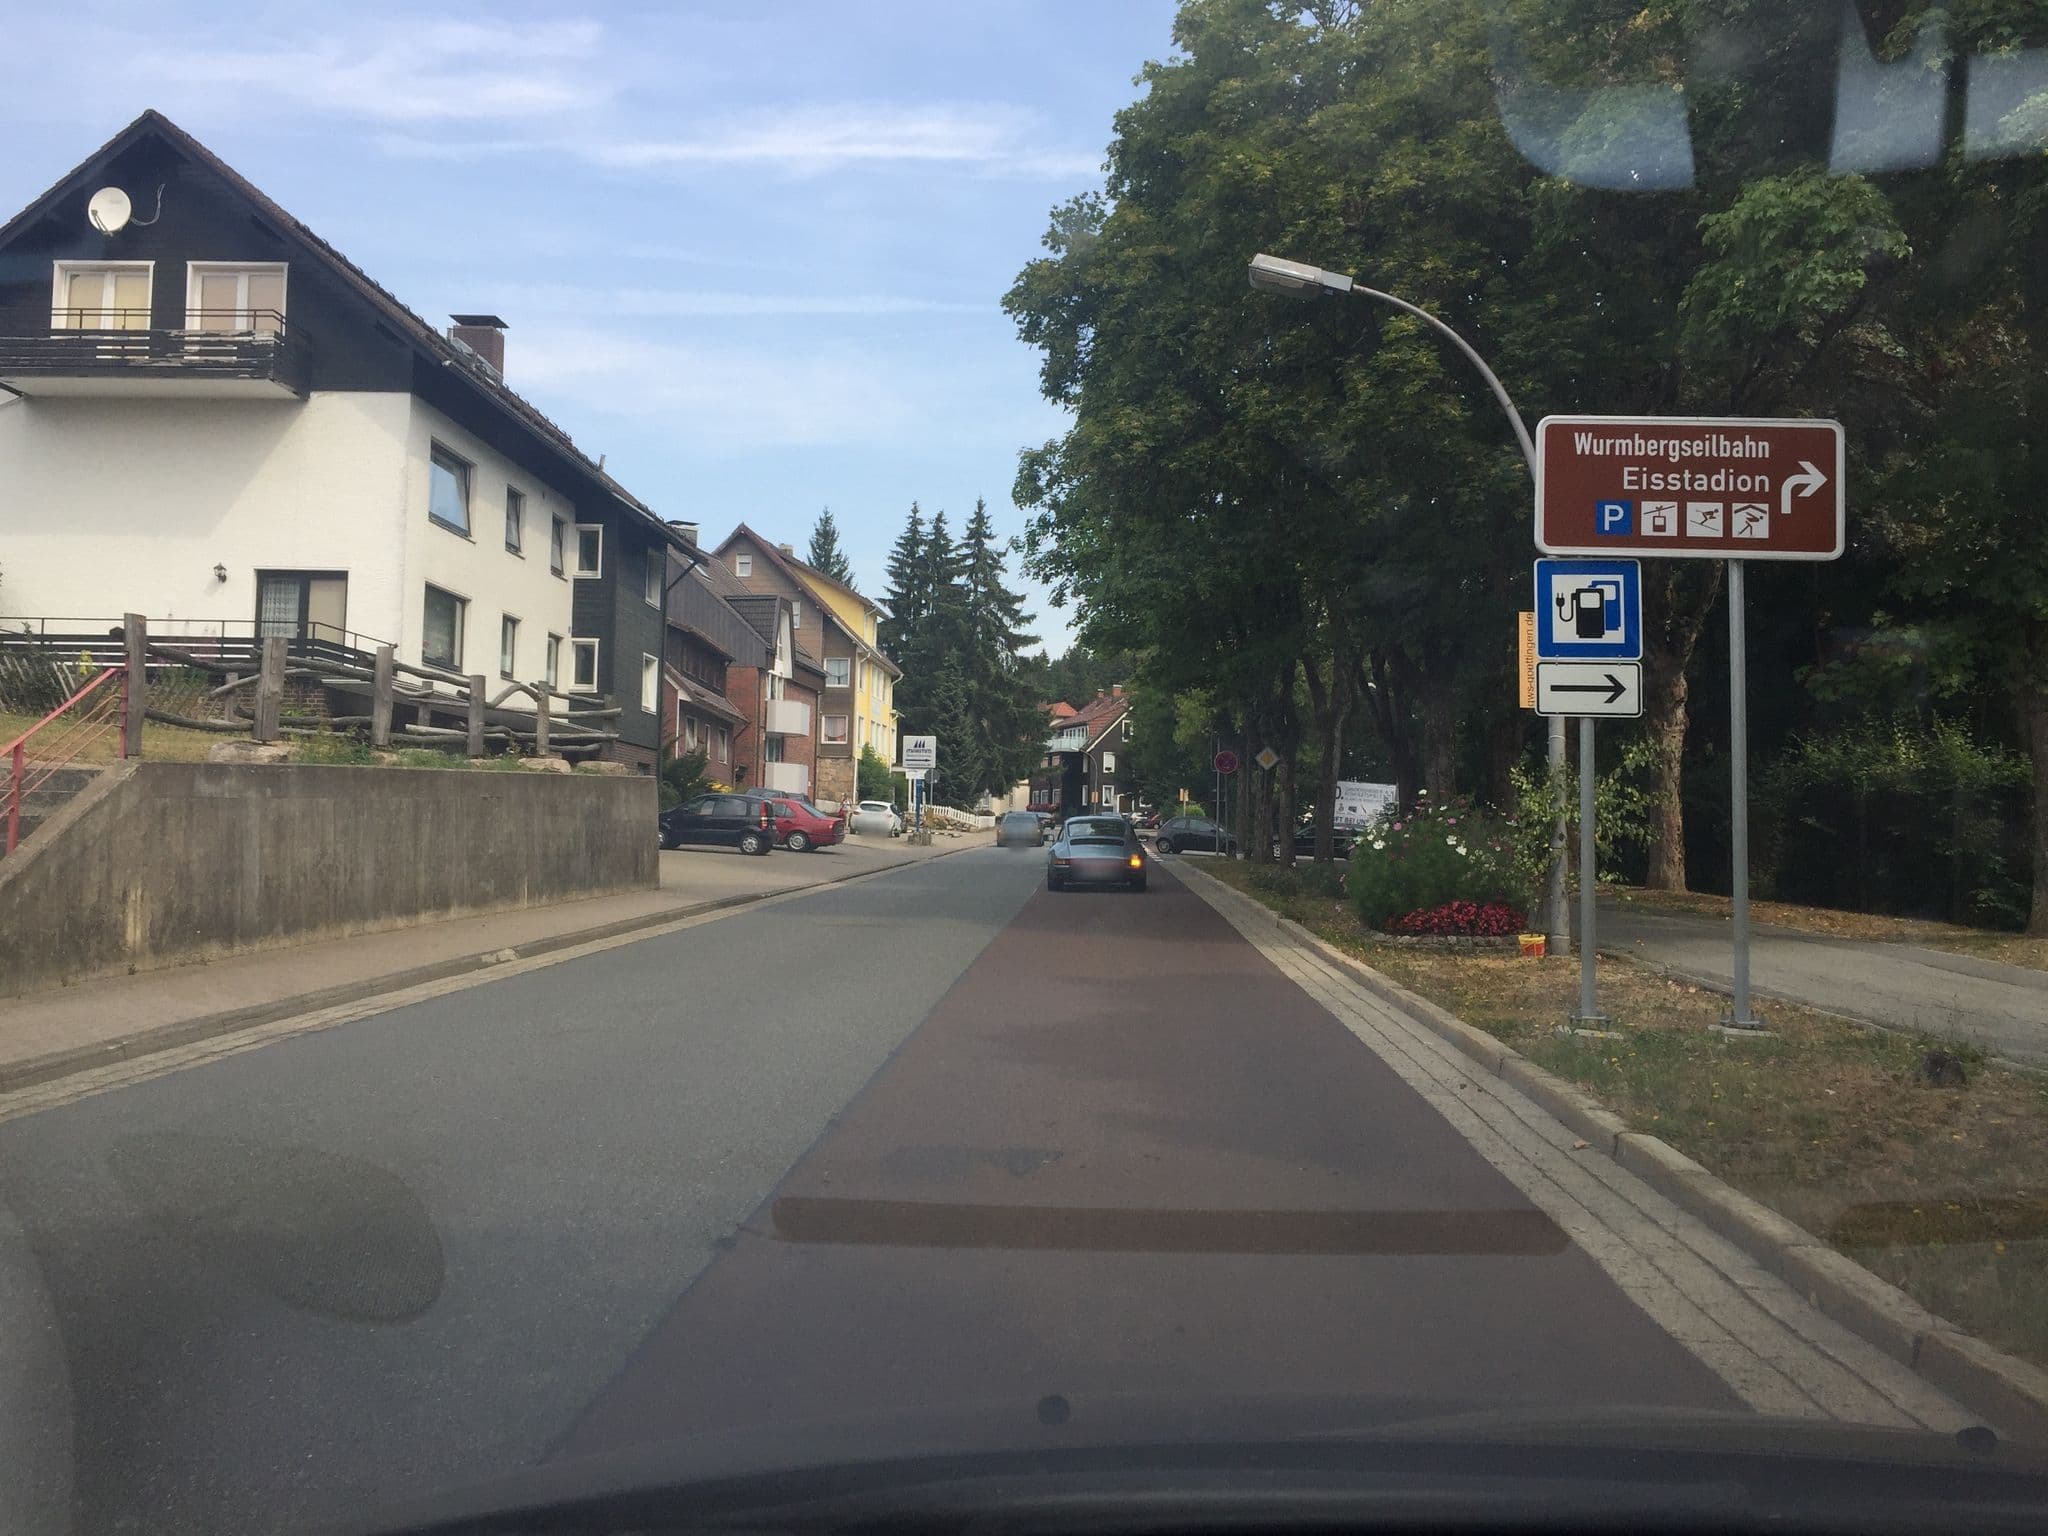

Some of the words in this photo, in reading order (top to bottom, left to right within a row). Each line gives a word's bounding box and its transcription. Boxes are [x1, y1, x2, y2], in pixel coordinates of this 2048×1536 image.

[1574, 432, 1770, 463] Wurmbergseilbahn
[1623, 466, 1770, 493] Eisstadion
[1603, 504, 1625, 531] P
